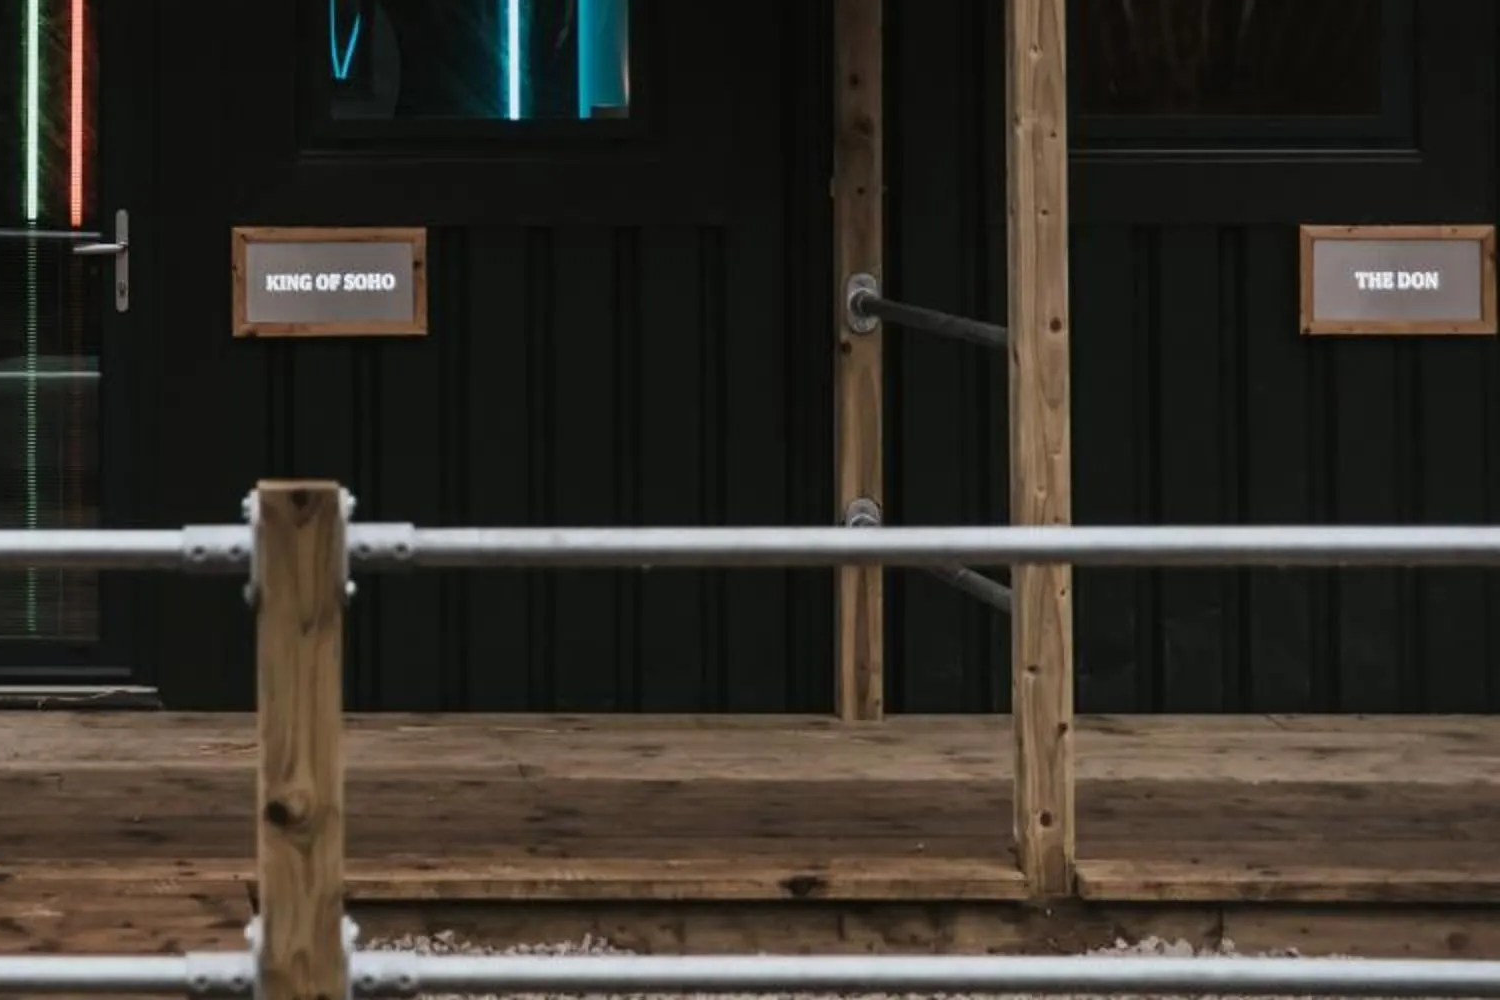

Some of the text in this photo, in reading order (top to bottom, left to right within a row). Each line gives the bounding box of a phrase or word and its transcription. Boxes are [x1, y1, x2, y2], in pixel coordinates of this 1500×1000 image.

[266, 273, 396, 291] KING OF SOHO
[1355, 271, 1439, 290] THE DON
